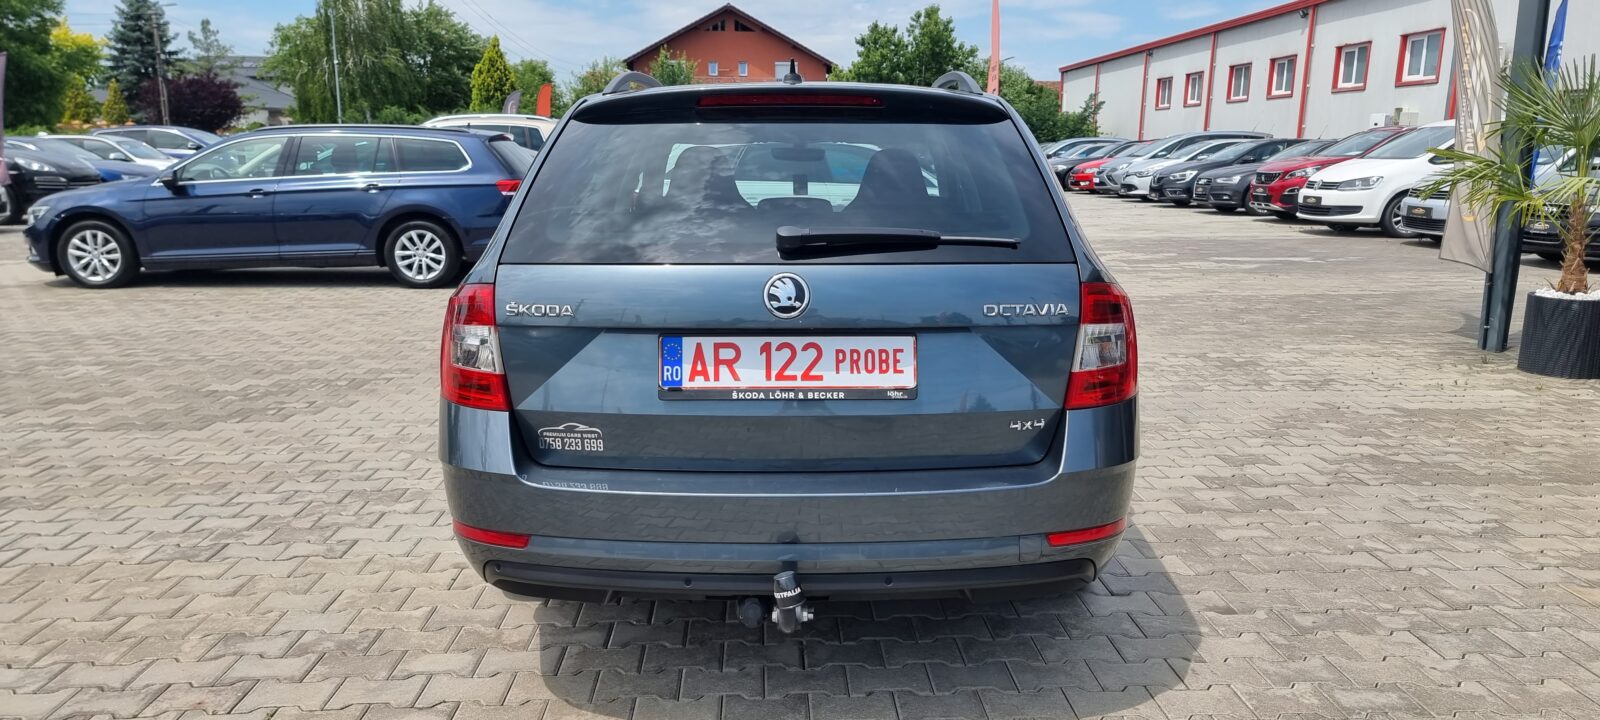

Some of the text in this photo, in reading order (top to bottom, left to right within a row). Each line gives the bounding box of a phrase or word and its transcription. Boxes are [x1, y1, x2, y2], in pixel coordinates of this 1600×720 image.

[505, 301, 575, 317] ŠKODA
[983, 303, 1069, 317] OCTAVIA
[688, 341, 905, 382] AR 122 PROBE
[663, 365, 681, 382] RO
[732, 390, 765, 399] ŠKODA
[798, 391, 804, 399] &
[807, 391, 845, 399] BECKER
[538, 437, 604, 452] 0758 233 699
